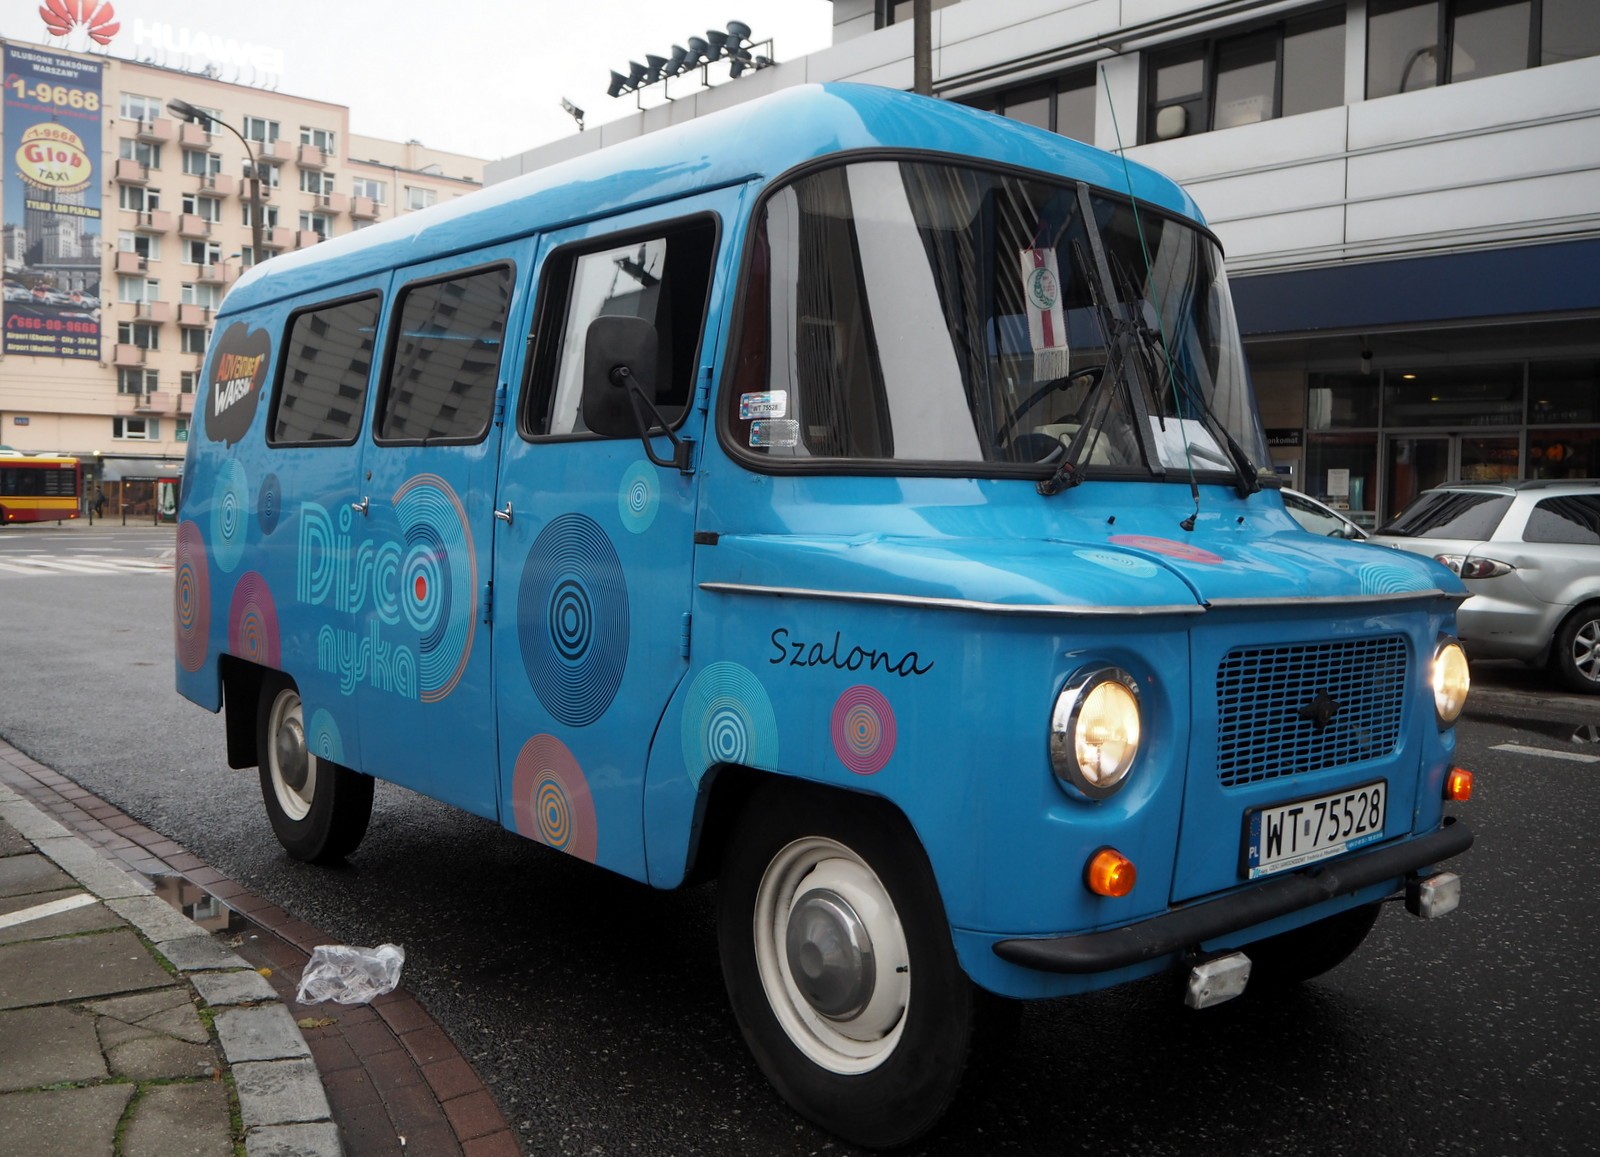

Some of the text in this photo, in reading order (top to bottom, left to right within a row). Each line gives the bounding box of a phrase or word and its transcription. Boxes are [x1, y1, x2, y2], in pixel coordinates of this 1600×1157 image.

[133, 17, 284, 75] HUAWEI
[10, 49, 98, 73] ULUBIONE TAKSÓWKI
[32, 63, 79, 79] WARSZAWY
[12, 79, 99, 111] 1-9668
[24, 143, 82, 168] Glob
[39, 167, 70, 182] TAXI
[1267, 436, 1298, 445] ankomat
[297, 500, 446, 634] Disco
[769, 628, 934, 677] Szalona
[1266, 788, 1381, 859] WT 75528
[1248, 846, 1259, 860] PL
